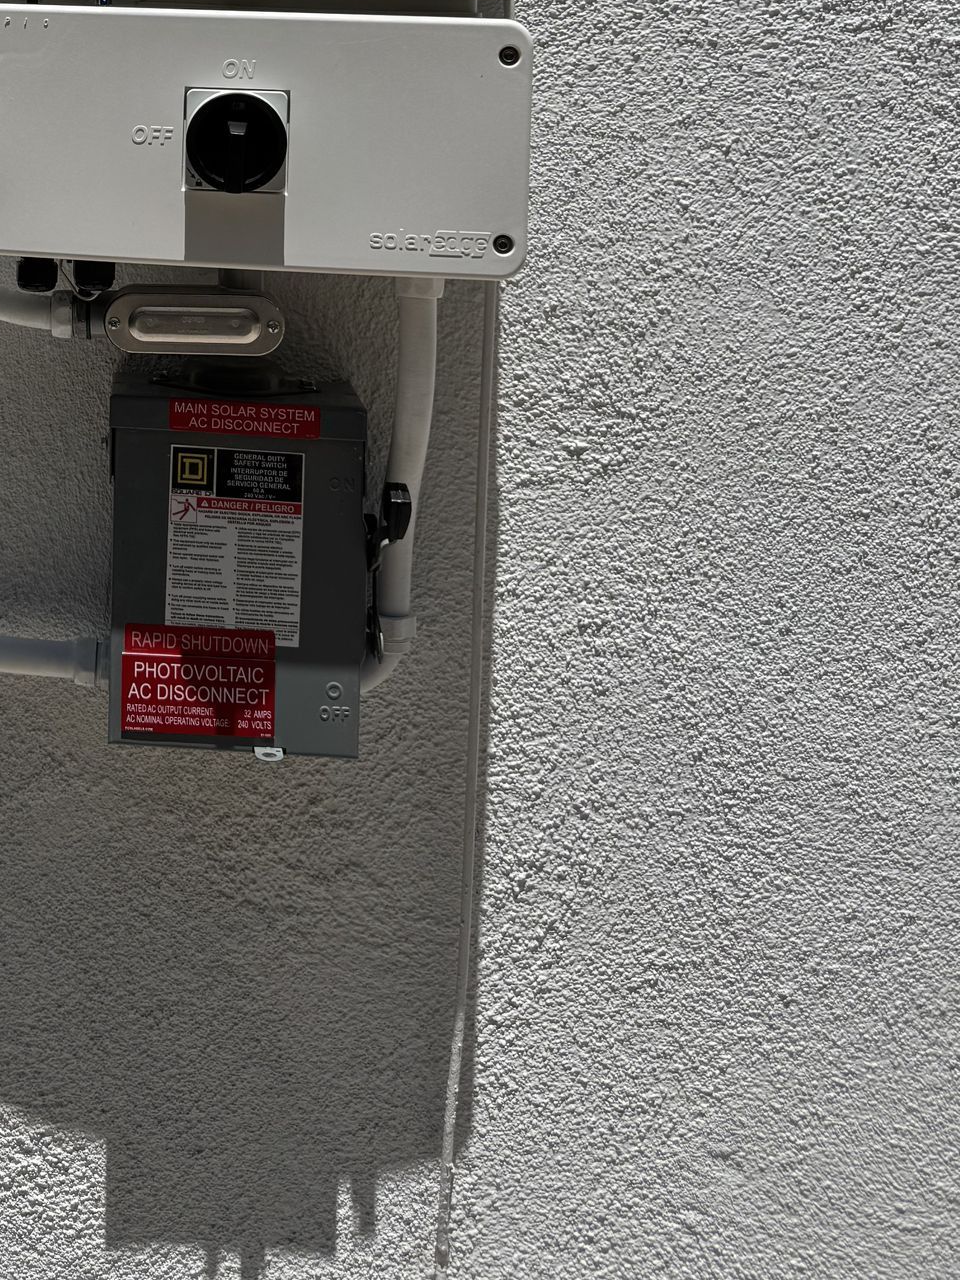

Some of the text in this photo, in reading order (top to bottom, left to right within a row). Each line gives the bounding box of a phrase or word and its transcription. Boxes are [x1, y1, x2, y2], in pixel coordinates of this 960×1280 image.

[222, 58, 257, 79] ON
[130, 125, 174, 146] OFF
[174, 402, 315, 421] MAIN SOLAR SYSTEM
[188, 418, 300, 434] AC DISCONNECT
[231, 468, 277, 476] INTERRUPTOR
[234, 474, 274, 482] SEGURIDAD
[227, 480, 291, 490] SERVICIO GENERAL
[211, 500, 248, 510] DANGER
[255, 503, 295, 513] PELIGRO
[132, 631, 269, 654] RAPID SHUTDOWN
[134, 661, 264, 684] PHOTOVOLTAIC
[128, 683, 269, 705] AC DISCONNECT
[126, 704, 147, 713] RATED
[147, 705, 156, 713] AC
[157, 705, 183, 714] OUTPUT
[244, 710, 251, 718] 32
[254, 710, 272, 719] AMPS
[319, 705, 350, 722] OFF
[126, 714, 135, 723] AC
[136, 715, 163, 725] NOMINAL
[165, 716, 200, 727] OPERATING
[238, 720, 249, 729] 240
[251, 720, 272, 730] VOLTS
